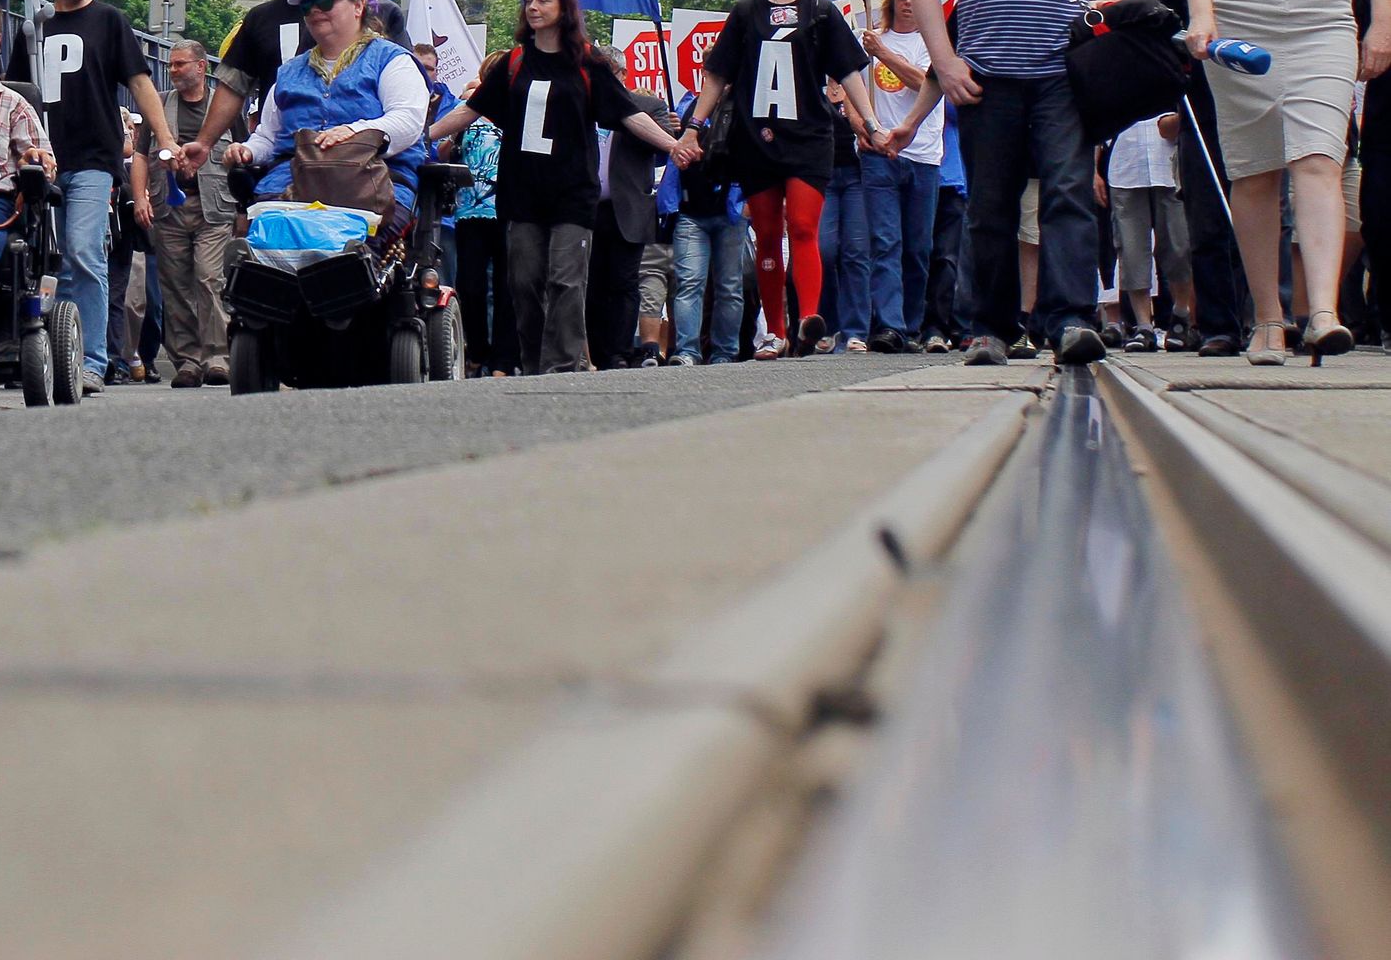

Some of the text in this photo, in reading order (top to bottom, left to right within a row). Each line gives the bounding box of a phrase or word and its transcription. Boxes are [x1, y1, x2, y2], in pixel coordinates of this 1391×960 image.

[43, 34, 84, 103] P
[634, 40, 671, 72] STO
[752, 28, 798, 121] Á
[520, 80, 553, 155] L
